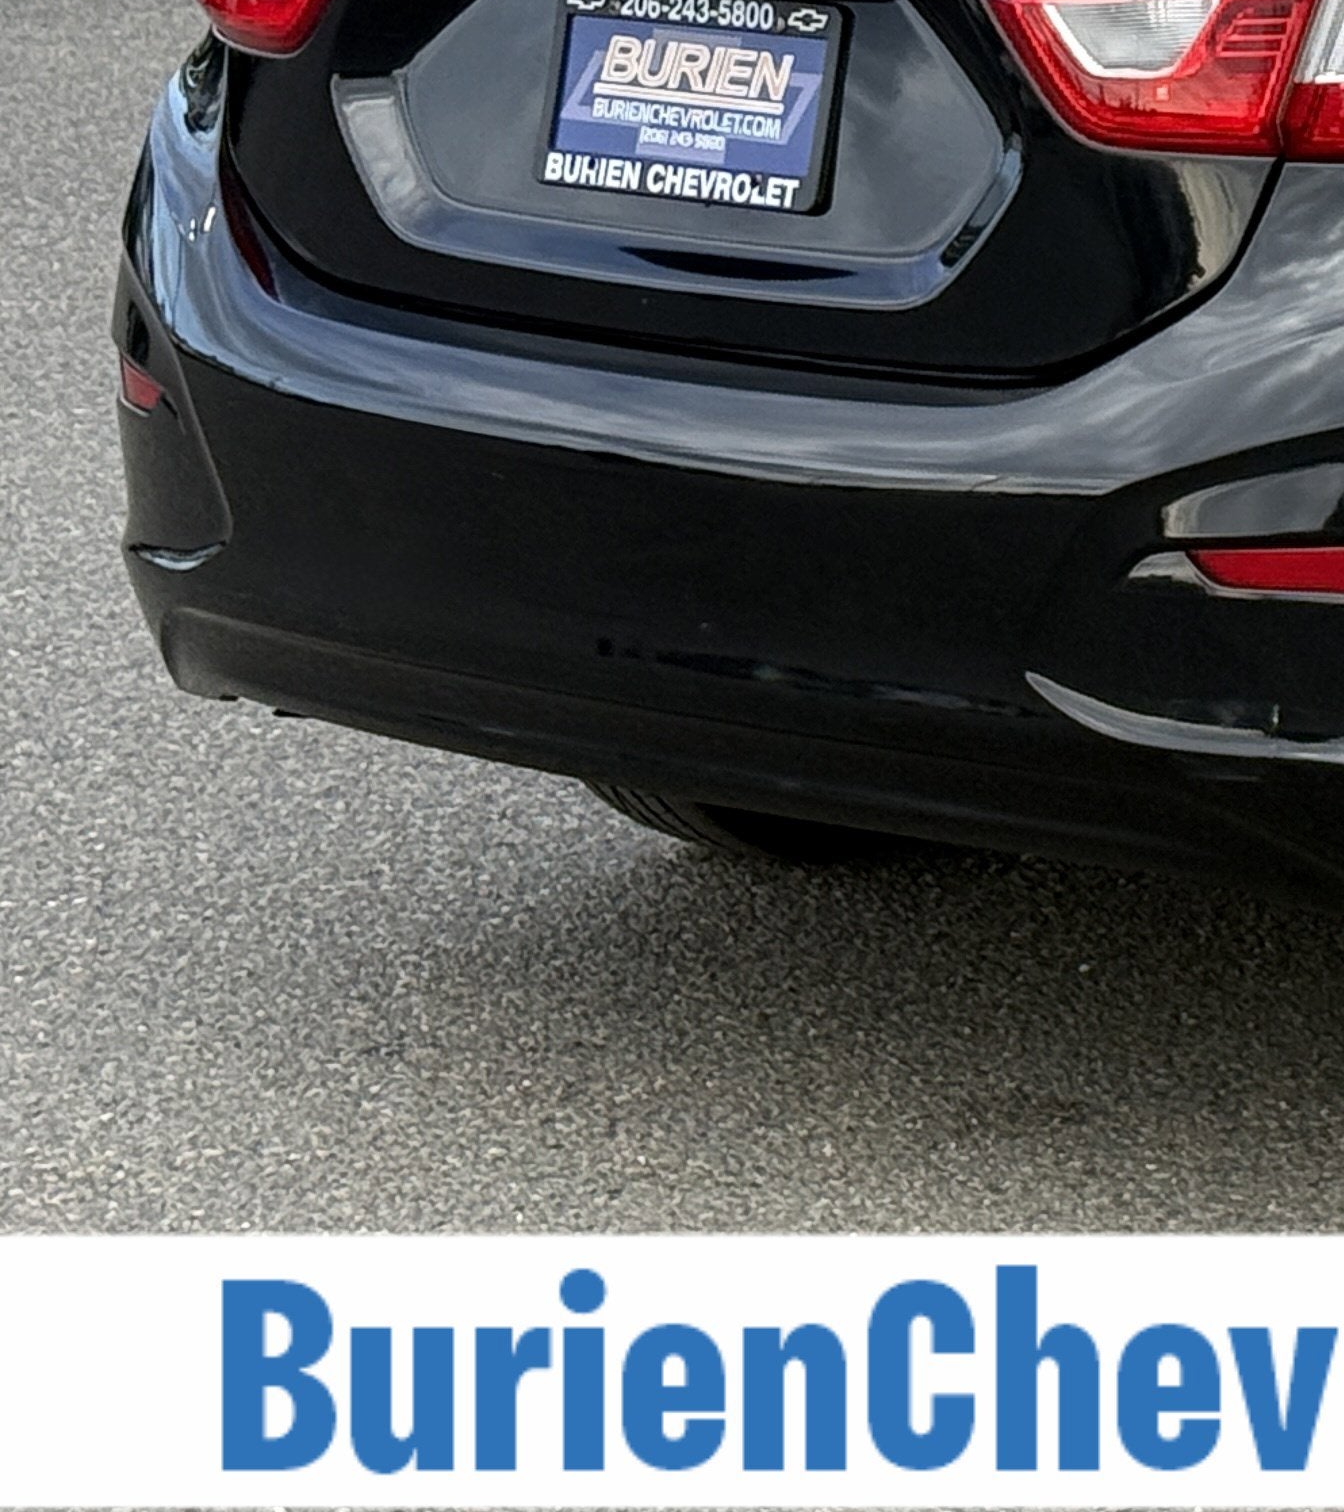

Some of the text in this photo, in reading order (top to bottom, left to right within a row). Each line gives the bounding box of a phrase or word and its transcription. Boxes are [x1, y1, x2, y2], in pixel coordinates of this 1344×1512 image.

[600, 34, 796, 101] BURIEN
[592, 97, 783, 141] BURIENCHEVROLET.COM
[544, 151, 800, 209] BURIEN CHEVROLET
